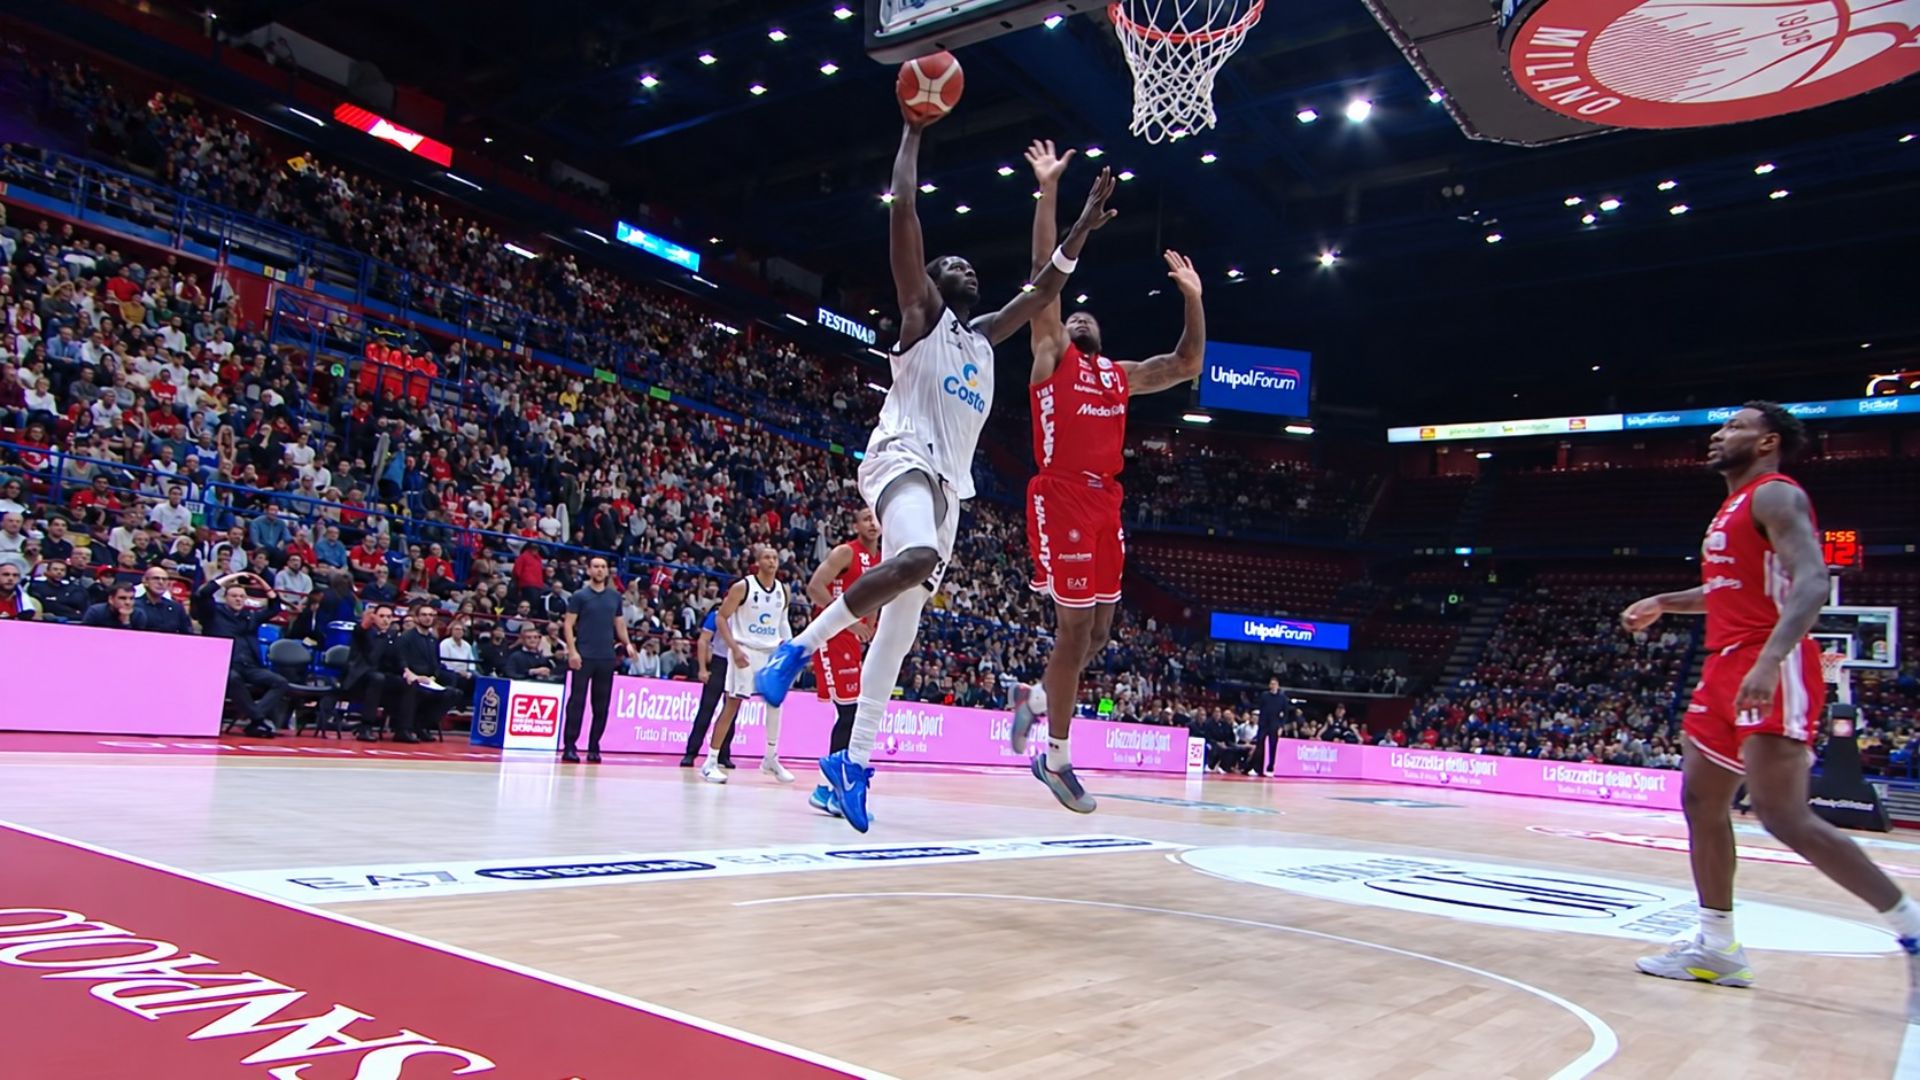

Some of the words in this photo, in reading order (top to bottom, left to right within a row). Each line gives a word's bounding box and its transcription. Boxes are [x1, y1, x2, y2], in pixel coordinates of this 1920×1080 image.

[1524, 25, 1621, 115] MILANO
[818, 308, 868, 343] FESTINA
[1211, 366, 1295, 390] UnipolForum
[943, 375, 985, 414] Costa
[1825, 530, 1856, 543] 1:55
[1067, 577, 1088, 588] EA7
[748, 623, 776, 636] Costa
[1244, 620, 1312, 641] UnipolForum
[513, 697, 556, 720] EA7
[616, 688, 634, 718] La
[634, 726, 659, 741] Tutto
[894, 709, 917, 735] dello
[917, 710, 944, 741] Sport
[991, 718, 1001, 740] La
[1391, 752, 1403, 768] La
[1404, 752, 1444, 771] Gazzetta
[1469, 758, 1498, 777] Sport
[1543, 765, 1556, 781] La
[1557, 765, 1604, 785] Gazzetta
[1605, 770, 1632, 788] dello
[1633, 771, 1666, 792] Sport
